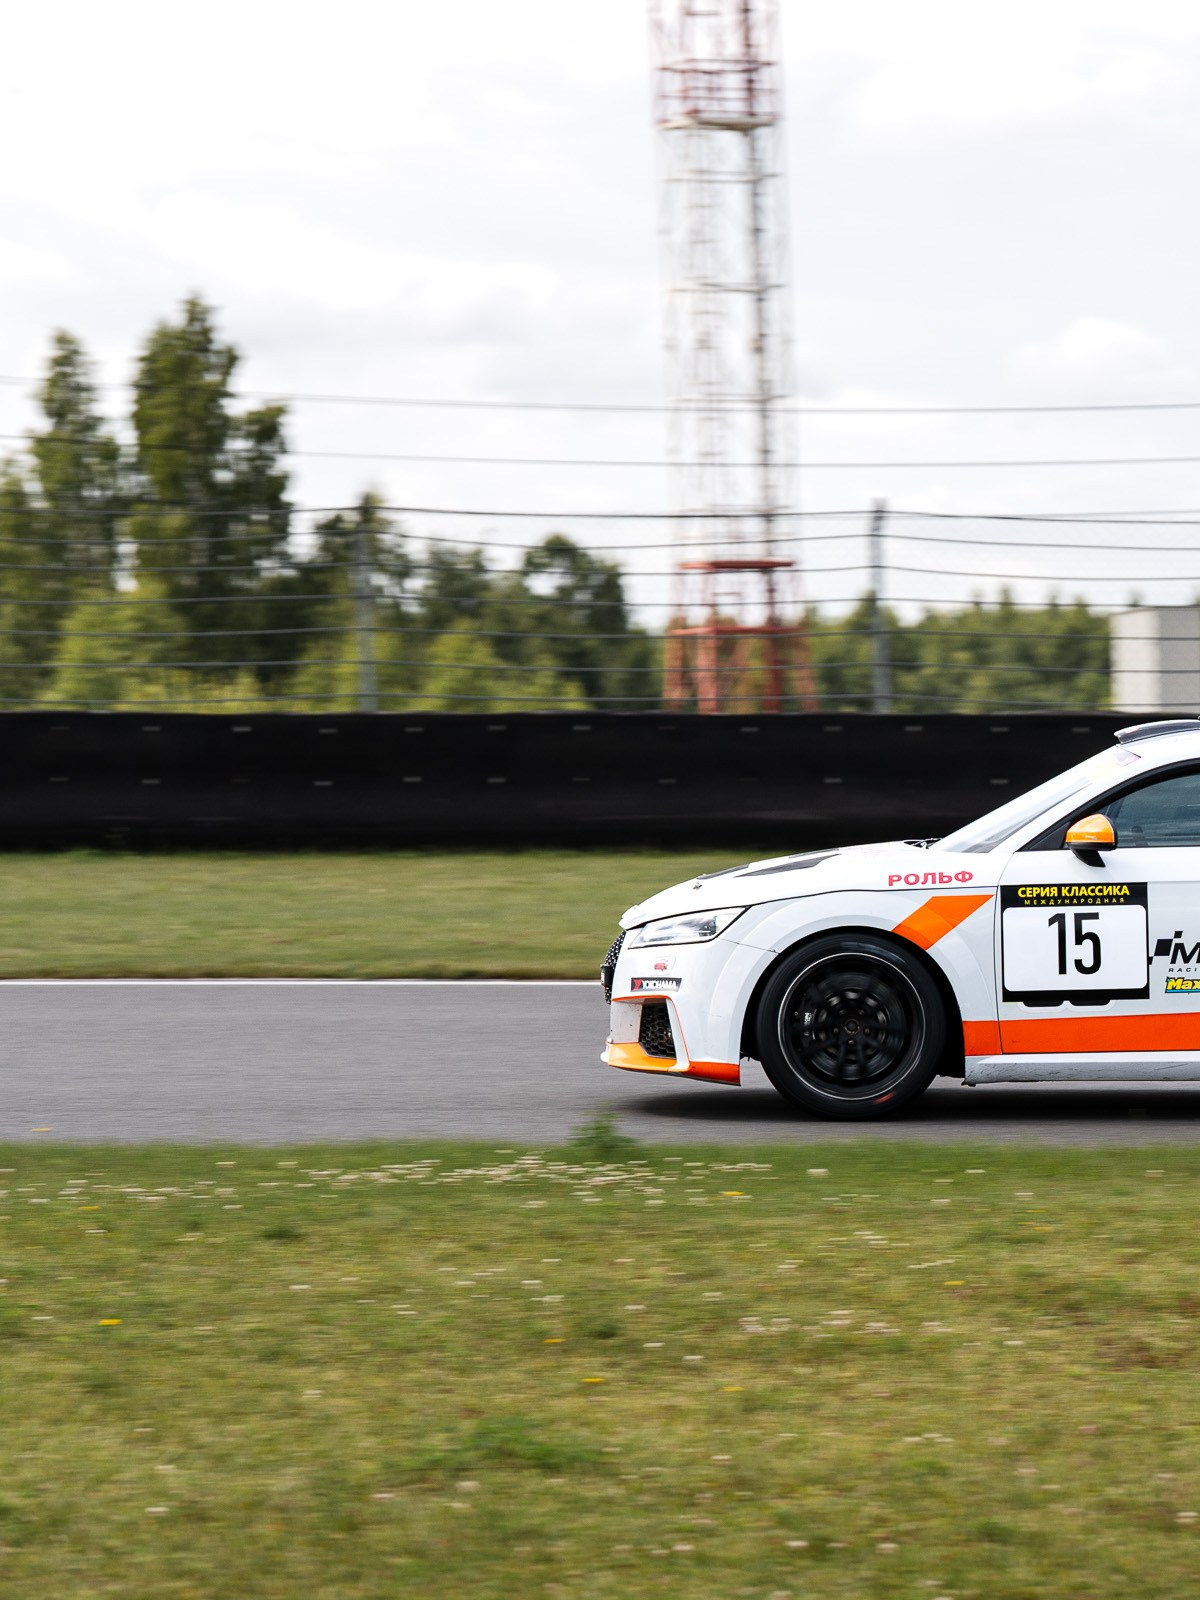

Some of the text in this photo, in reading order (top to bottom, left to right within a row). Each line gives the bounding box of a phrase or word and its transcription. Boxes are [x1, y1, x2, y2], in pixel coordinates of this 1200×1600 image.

[888, 870, 974, 887] РОЛЬФ
[1017, 885, 1130, 898] СЕРИЯ КЛАССИКА
[1048, 912, 1102, 975] 15
[642, 980, 677, 989] YOKOHAMA
